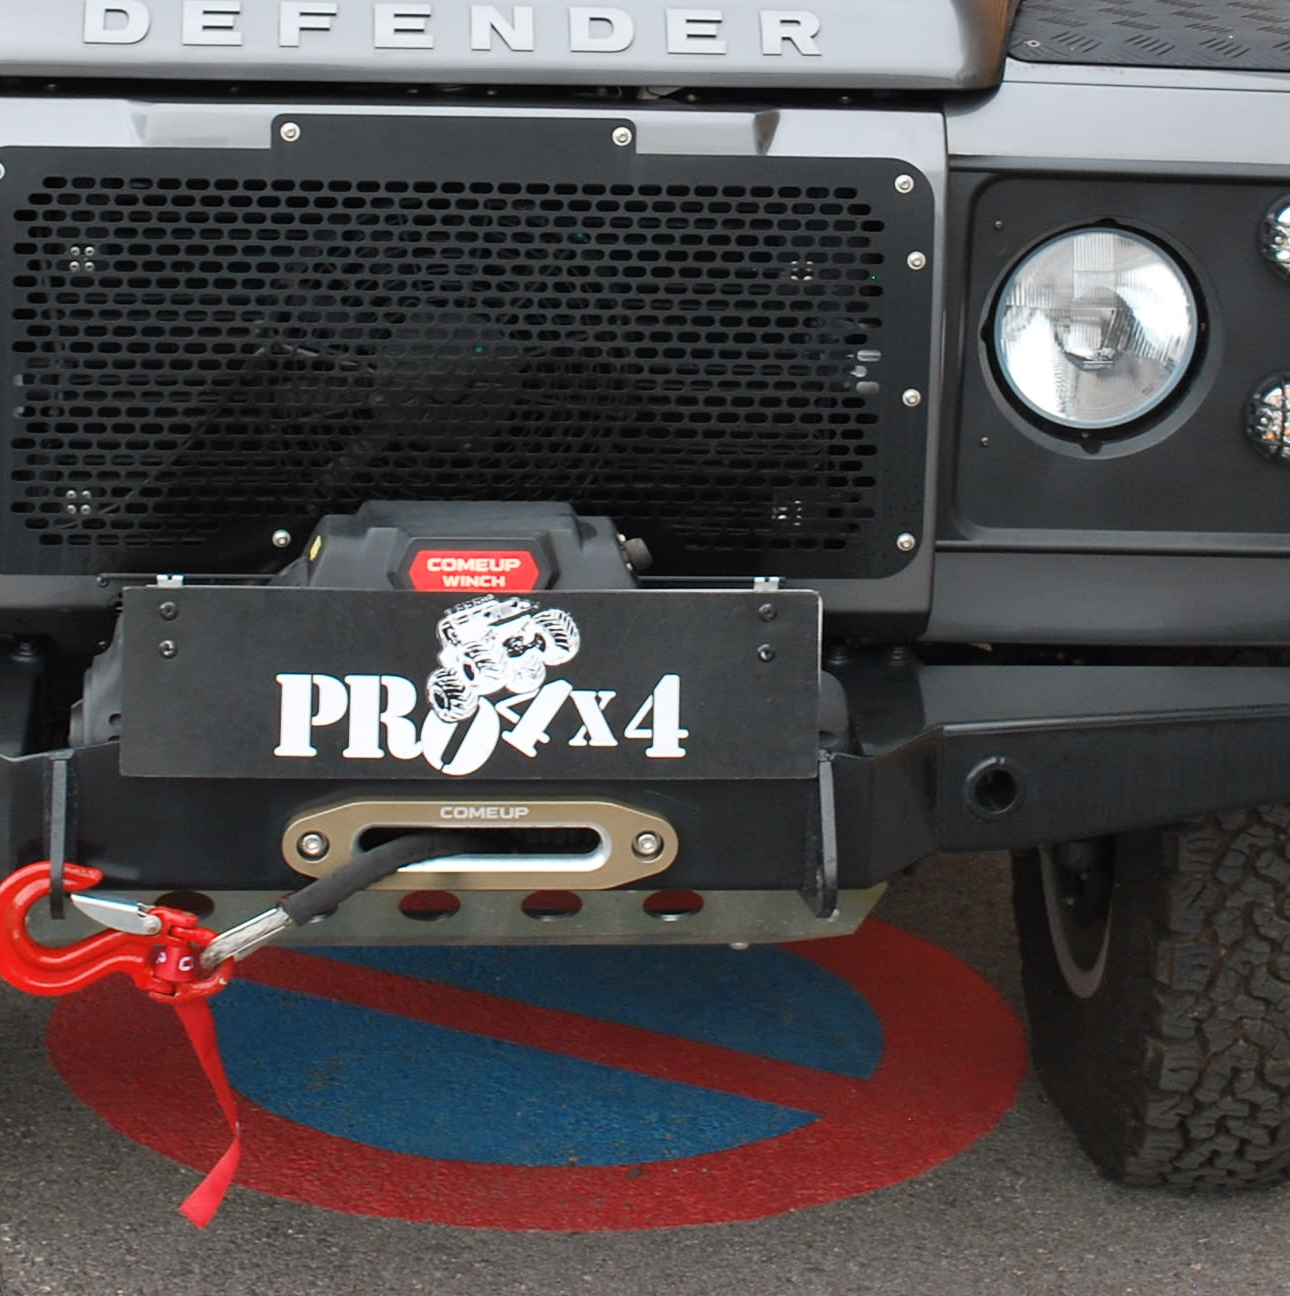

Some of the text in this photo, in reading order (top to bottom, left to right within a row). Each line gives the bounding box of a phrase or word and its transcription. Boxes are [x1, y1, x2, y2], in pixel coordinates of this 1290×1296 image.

[426, 557, 522, 572] COMEUP
[442, 575, 507, 588] WINCH
[439, 806, 530, 819] COMEUP
